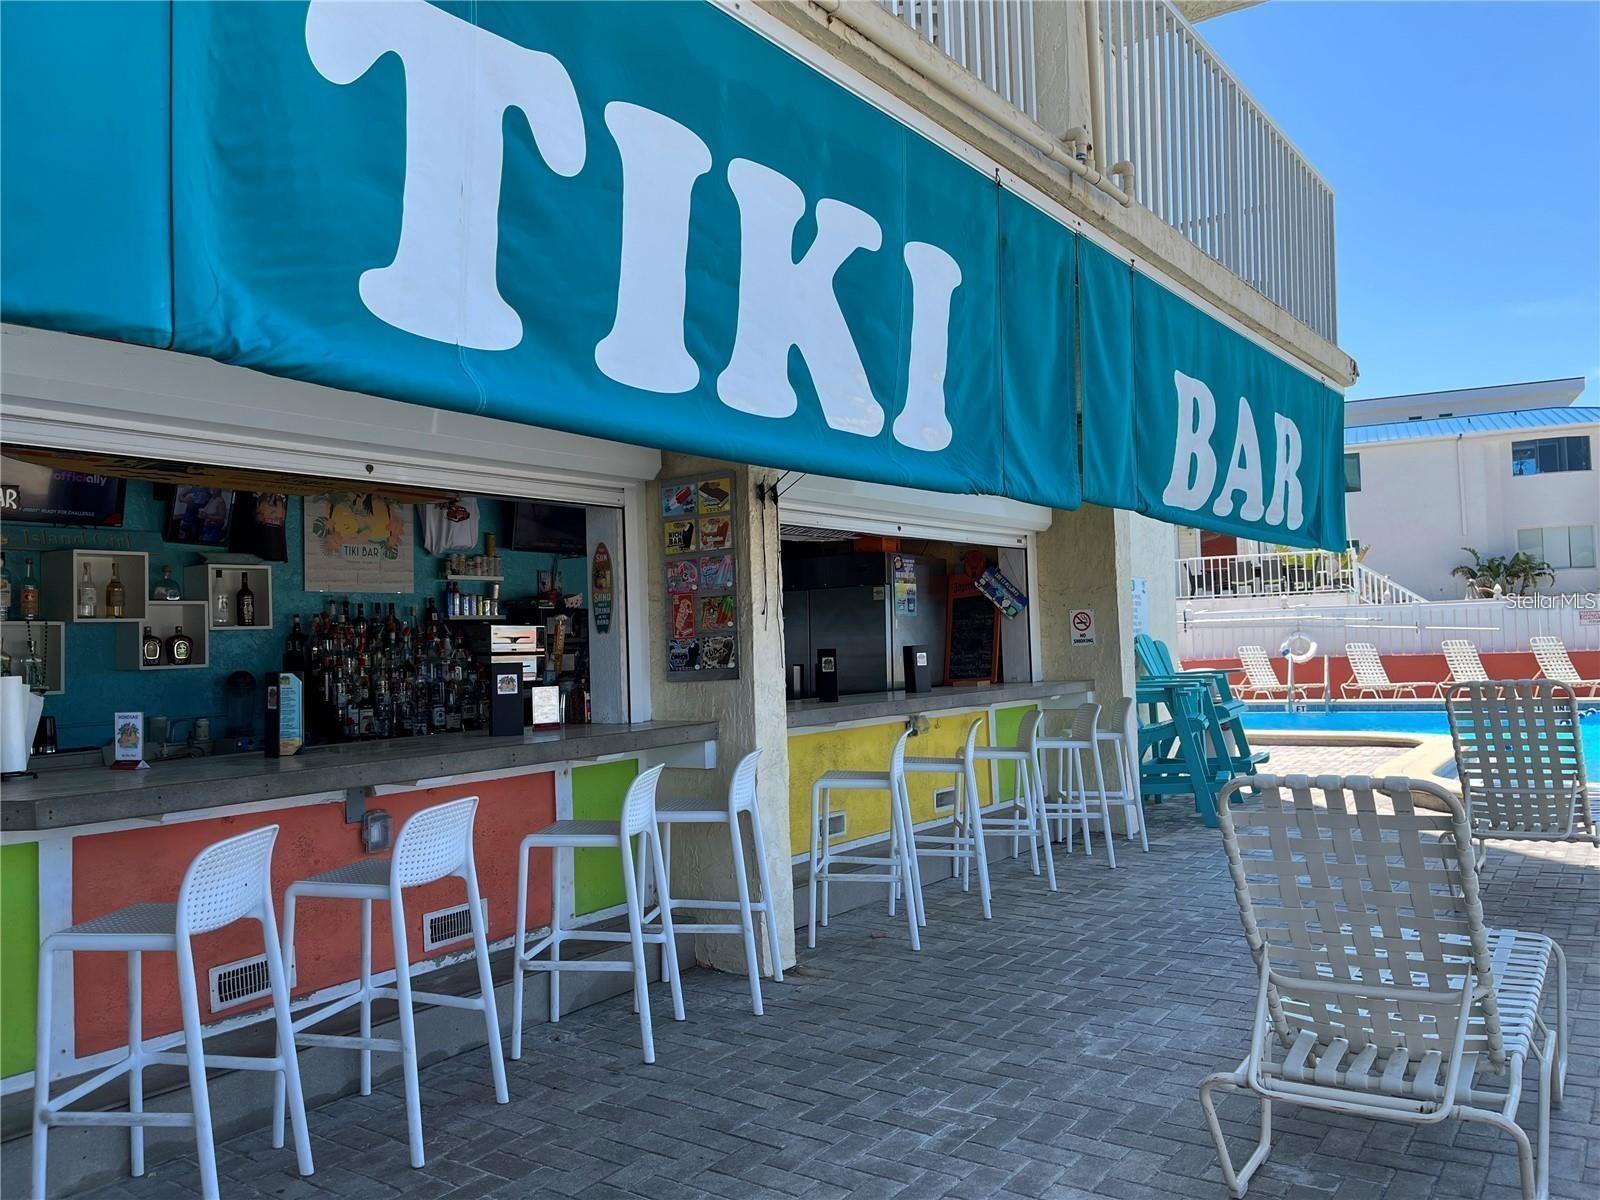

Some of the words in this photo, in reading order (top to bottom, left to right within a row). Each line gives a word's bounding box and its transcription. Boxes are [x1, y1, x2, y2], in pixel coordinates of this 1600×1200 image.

[305, 0, 962, 451] TIKI
[1162, 369, 1304, 530] BAR
[344, 545, 359, 557] TIKI
[361, 546, 379, 557] BAR
